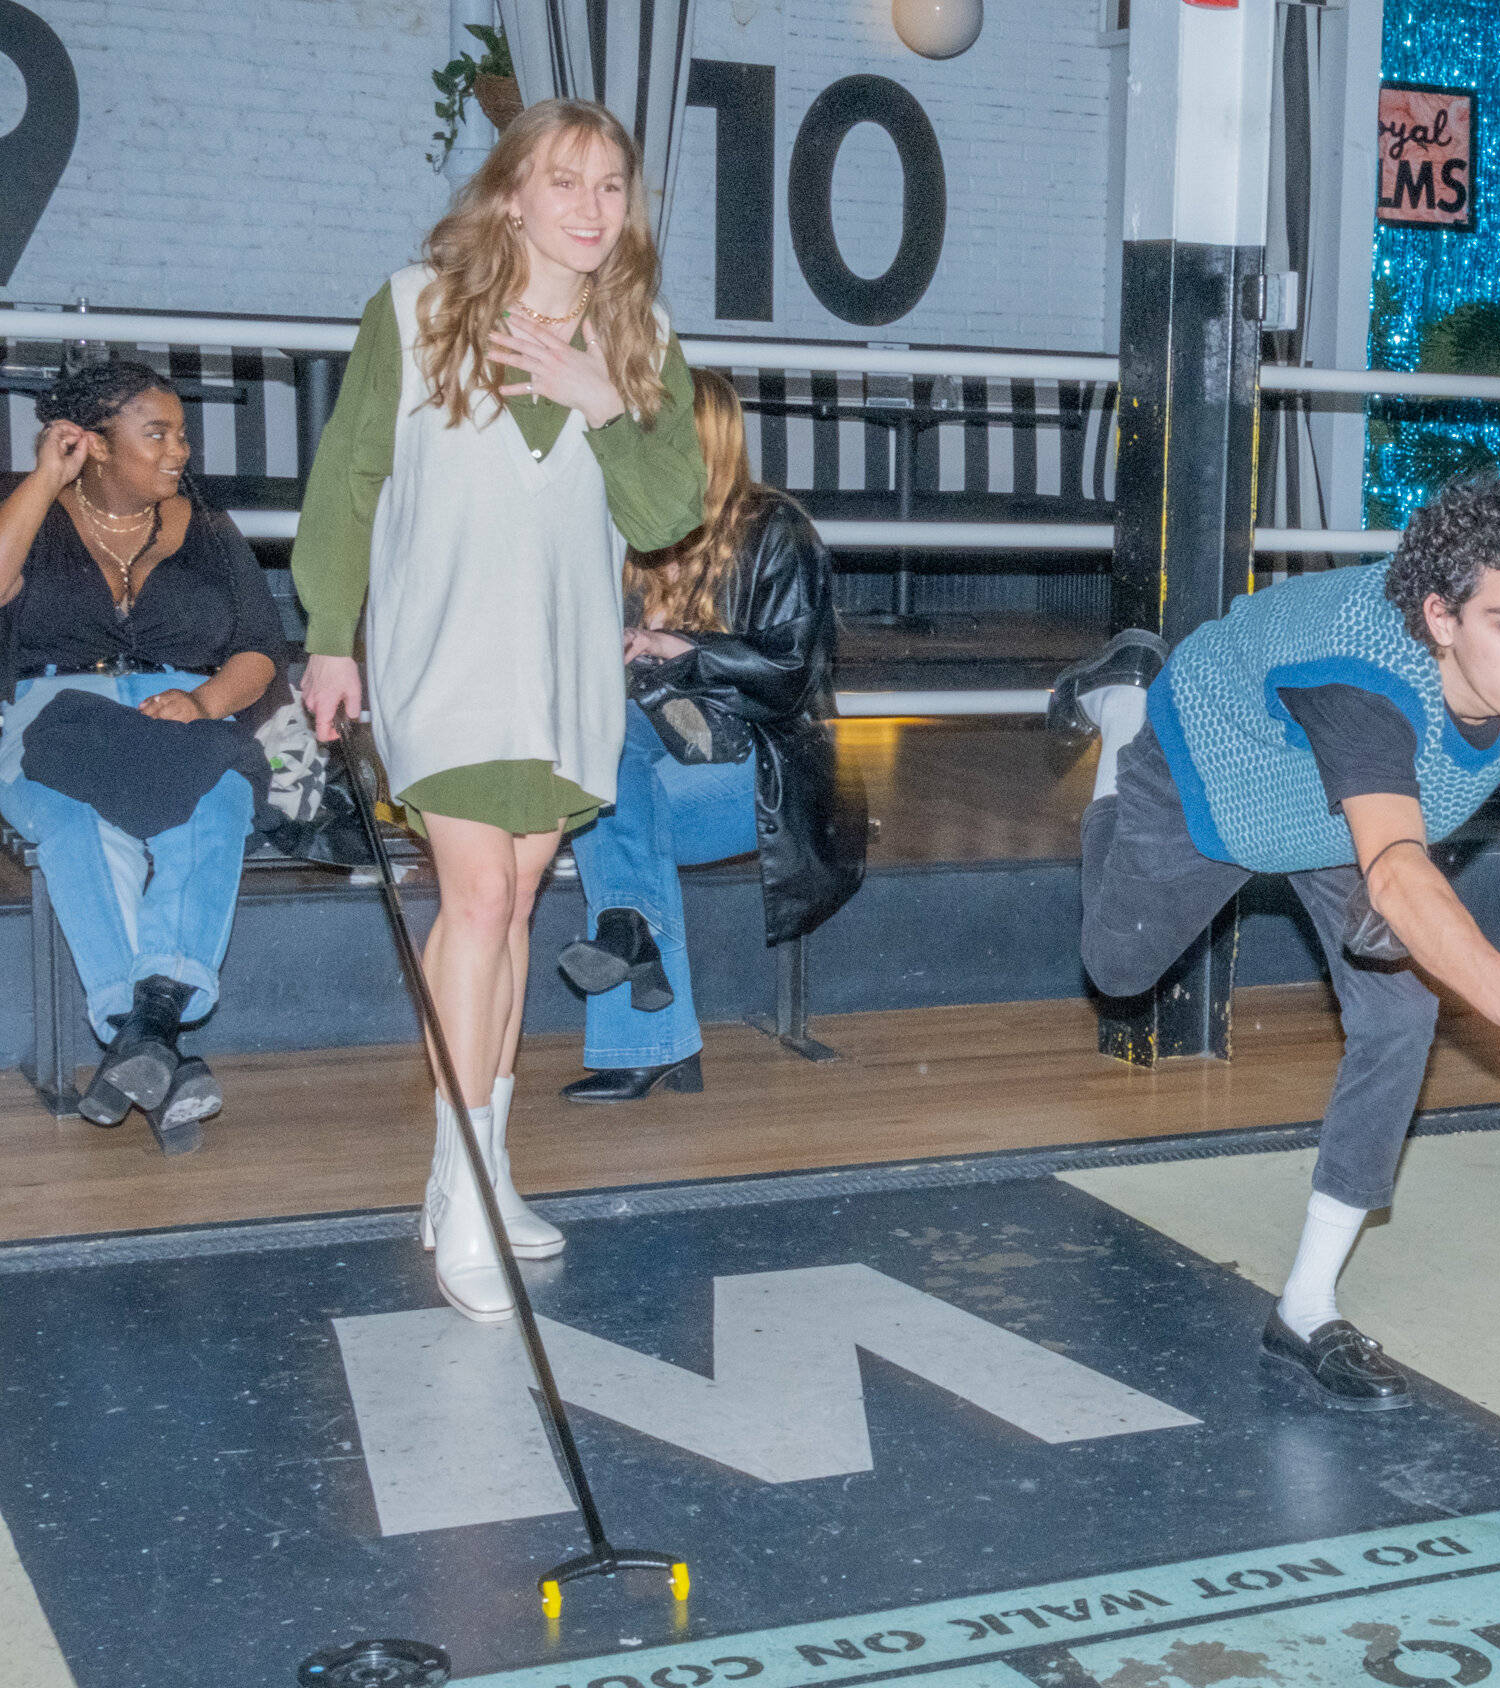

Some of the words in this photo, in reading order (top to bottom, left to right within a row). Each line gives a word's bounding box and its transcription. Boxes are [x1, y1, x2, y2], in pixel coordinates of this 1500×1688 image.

[687, 59, 948, 327] 10
[1378, 158, 1468, 213] LMS
[1363, 1536, 1471, 1567] DO
[1191, 1559, 1344, 1599] NOT
[949, 1590, 1171, 1641] WALK
[796, 1630, 927, 1667] ON
[555, 1656, 764, 1688] COU
